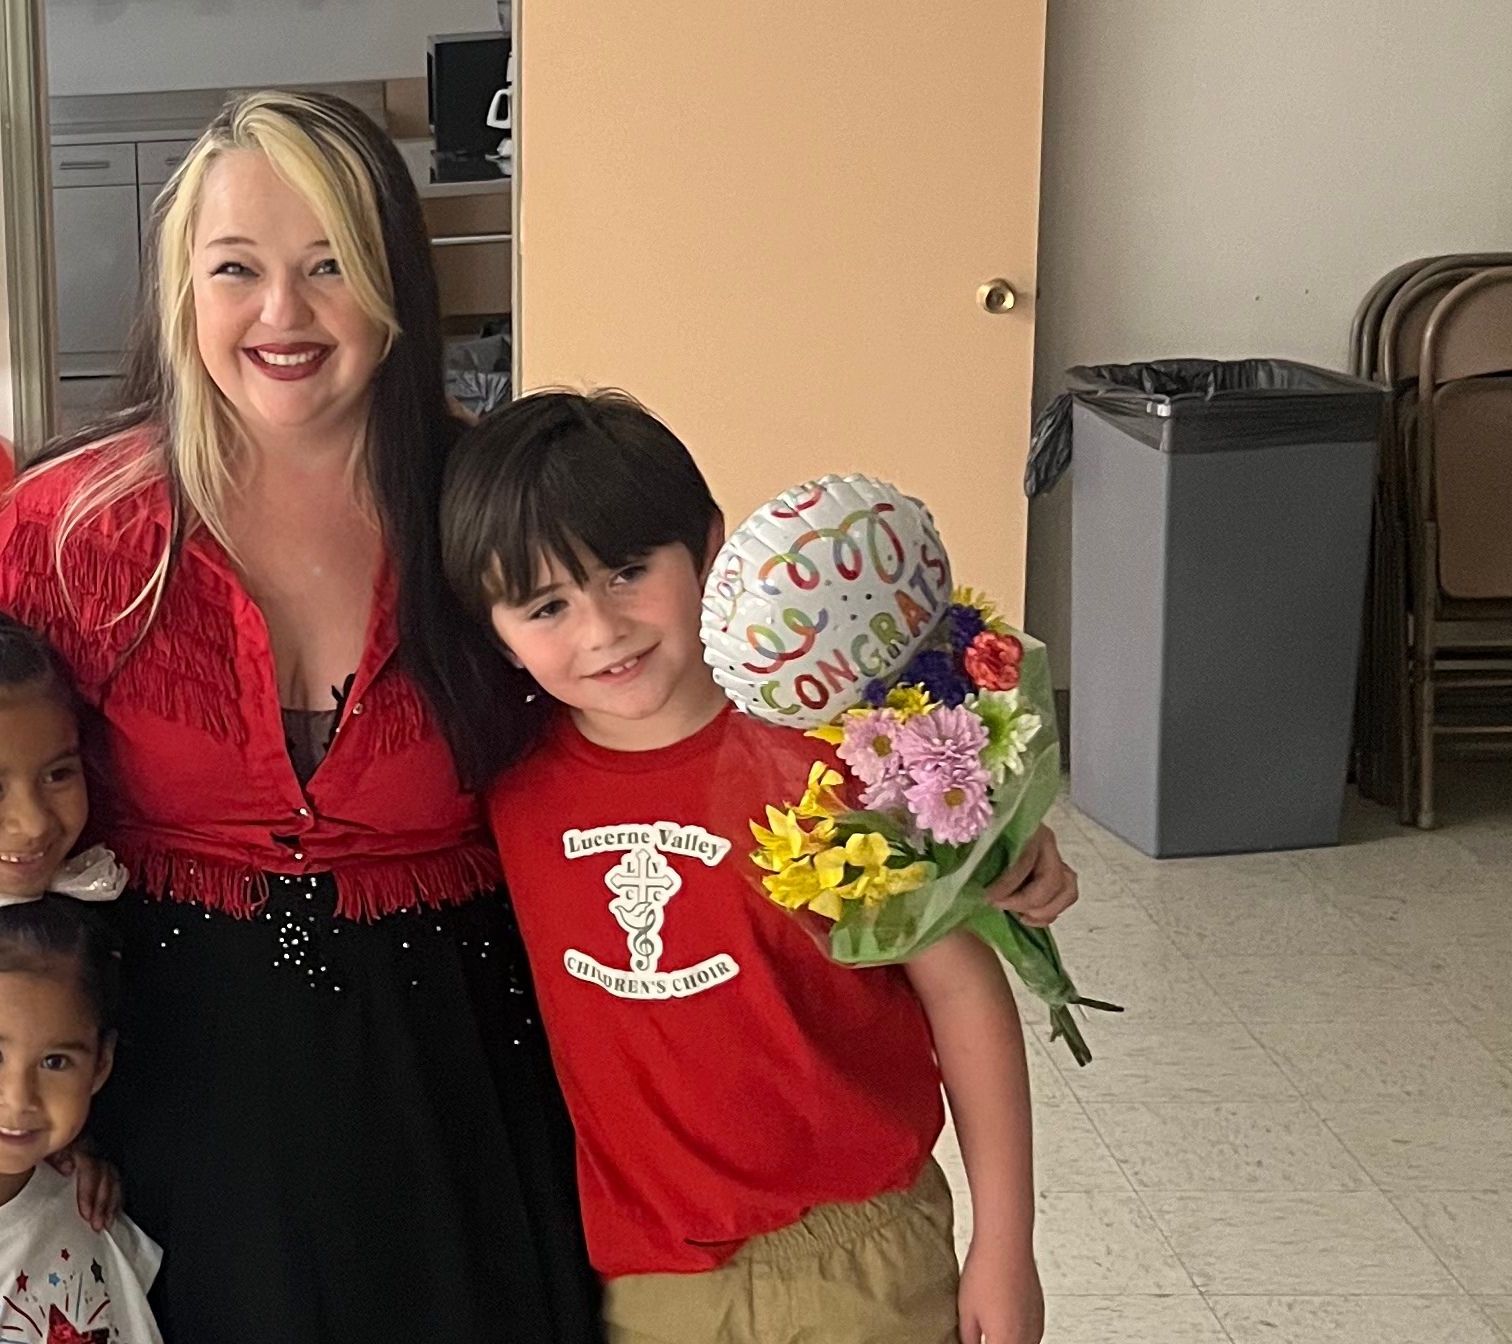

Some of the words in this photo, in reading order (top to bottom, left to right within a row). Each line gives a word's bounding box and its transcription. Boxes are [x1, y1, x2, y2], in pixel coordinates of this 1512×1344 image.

[760, 544, 945, 715] CONGRATS
[568, 830, 651, 853] Lucerne
[658, 828, 721, 861] Valley
[672, 960, 731, 992] CHOIR
